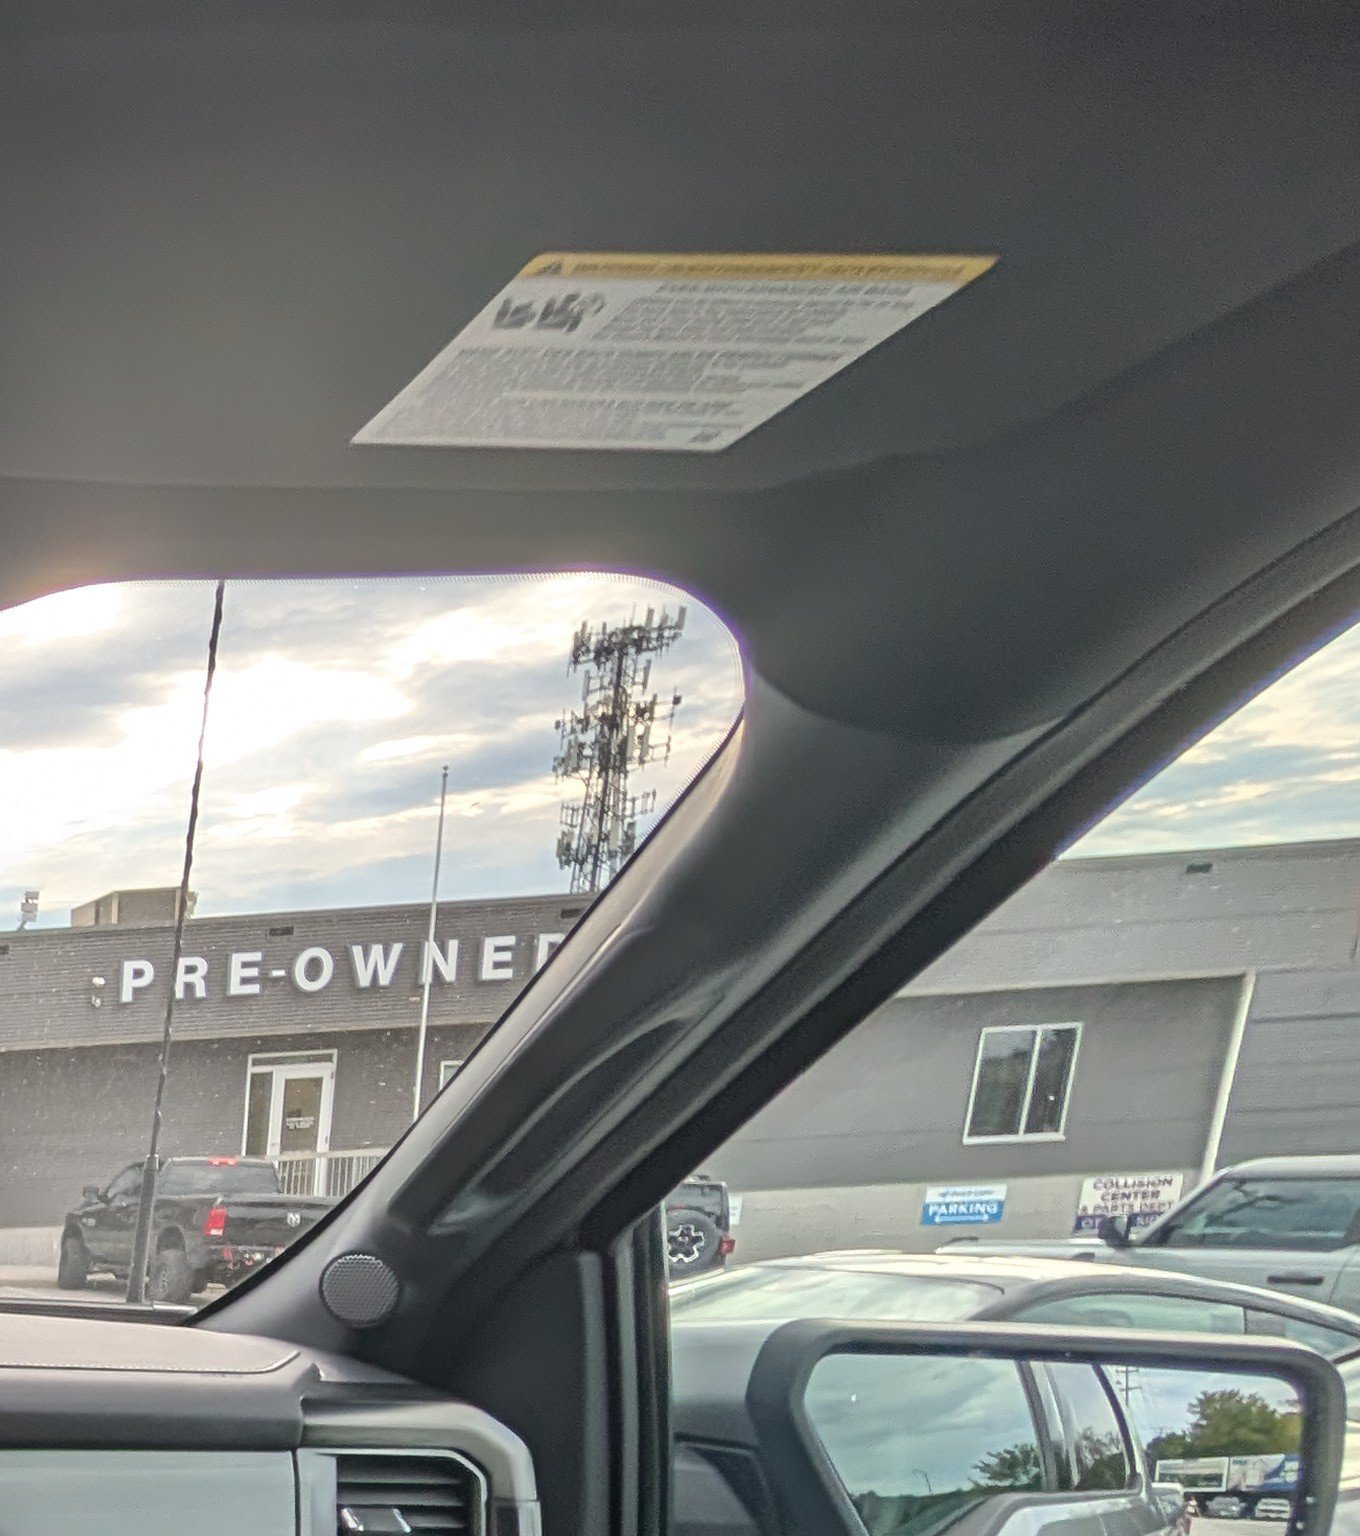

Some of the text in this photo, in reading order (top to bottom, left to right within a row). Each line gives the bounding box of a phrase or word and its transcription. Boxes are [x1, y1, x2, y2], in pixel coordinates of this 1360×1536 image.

[1092, 1177, 1174, 1190] COLLISION
[1100, 1189, 1161, 1201] CENTER
[928, 1203, 998, 1217] PARKING
